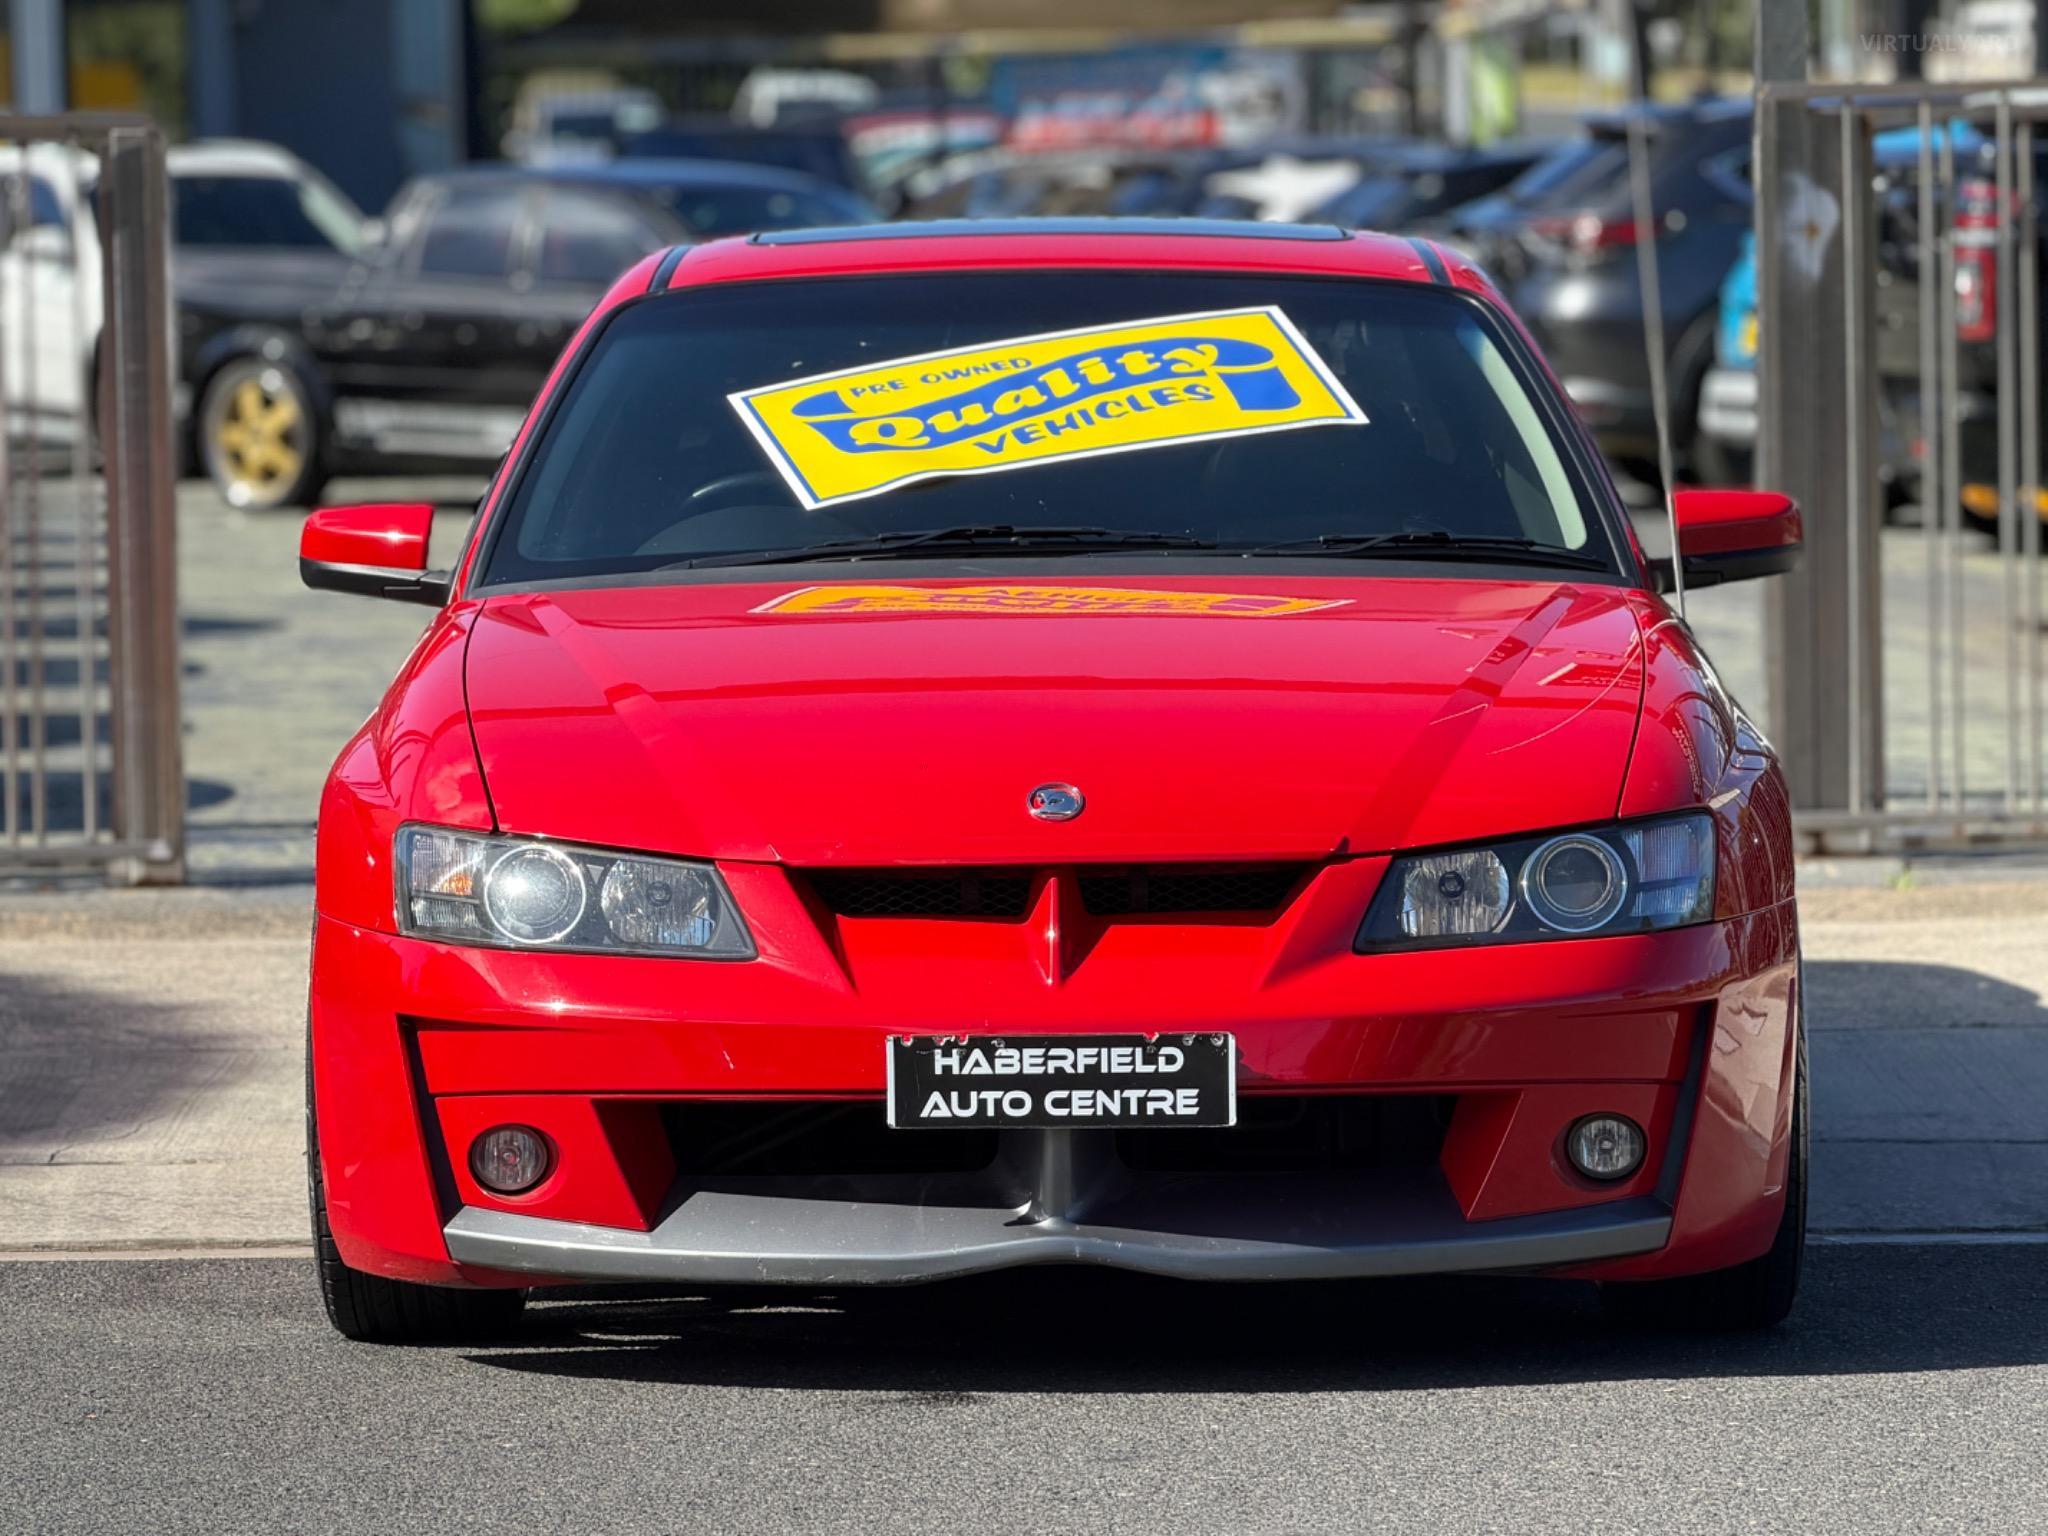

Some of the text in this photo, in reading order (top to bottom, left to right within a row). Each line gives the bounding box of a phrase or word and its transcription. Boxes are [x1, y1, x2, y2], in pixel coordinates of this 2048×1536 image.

[849, 358, 1032, 398] PRE OWNED
[849, 344, 1219, 447] Quality
[973, 384, 1215, 454] VEHICLES
[934, 1046, 1184, 1075] HABERFIELD
[920, 1088, 1200, 1118] AUTO CENTRE
